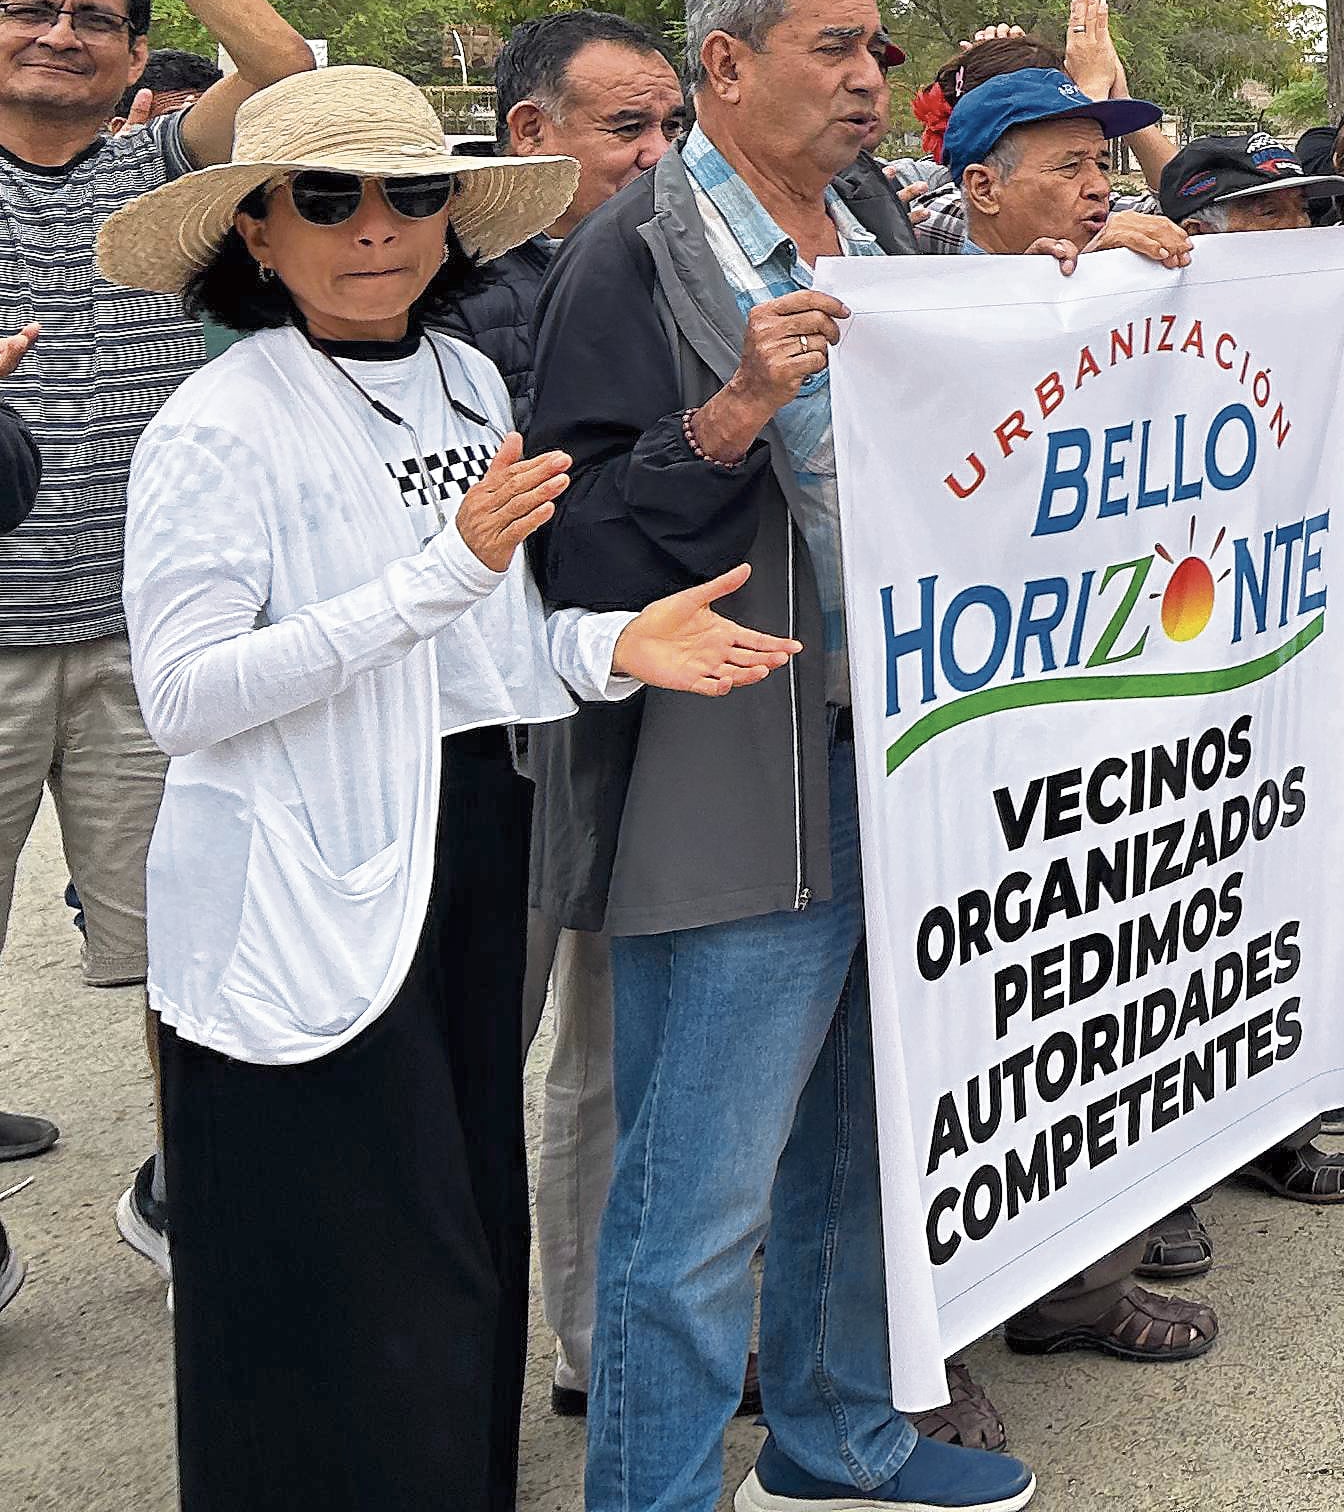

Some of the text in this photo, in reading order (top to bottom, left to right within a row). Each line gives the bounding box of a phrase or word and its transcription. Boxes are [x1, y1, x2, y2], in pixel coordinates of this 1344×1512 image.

[944, 315, 1292, 499] URBANIZACIÓN
[1030, 403, 1257, 537] BELLO
[880, 509, 1329, 717] HORIZONTE
[916, 766, 1306, 982] ORGANIZADOS
[993, 714, 1253, 851] VECINOS
[926, 920, 1302, 1176] AUTORIDADES
[994, 871, 1244, 1040] PEDIMOS
[926, 996, 1302, 1266] COMPETENTES
